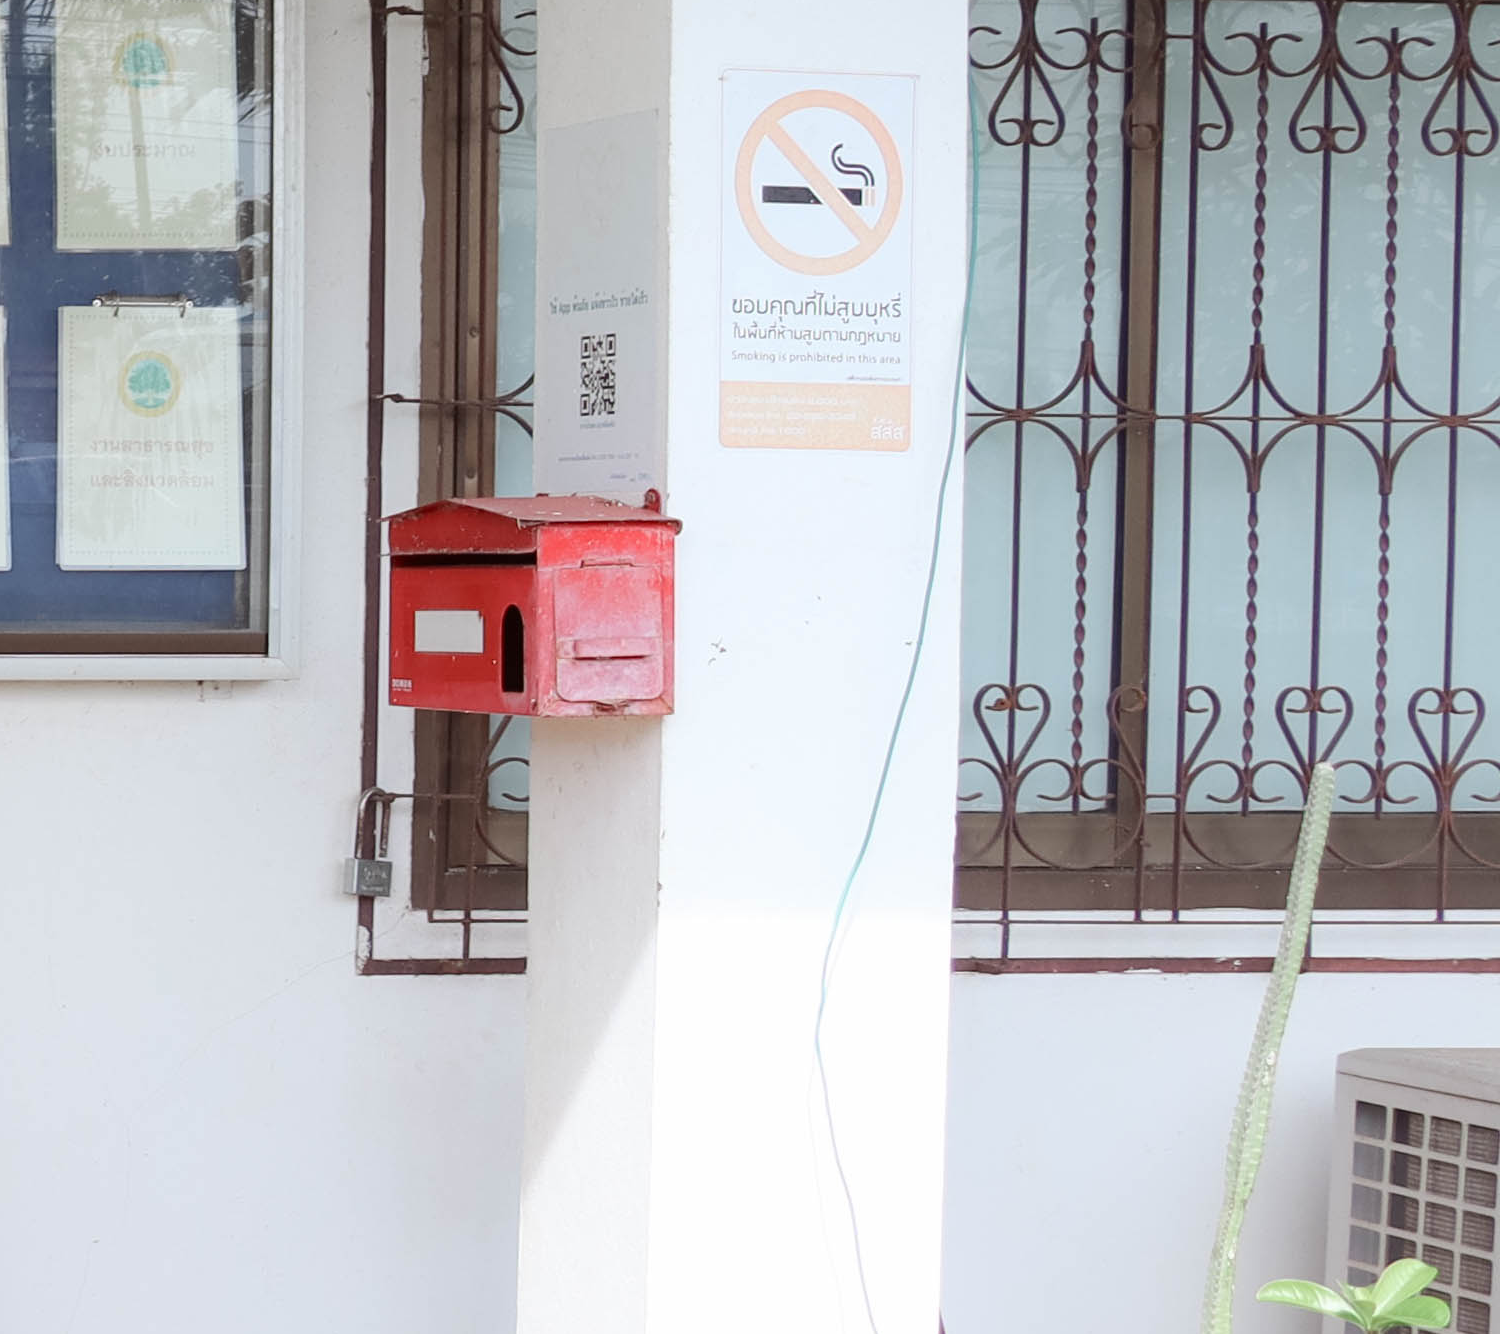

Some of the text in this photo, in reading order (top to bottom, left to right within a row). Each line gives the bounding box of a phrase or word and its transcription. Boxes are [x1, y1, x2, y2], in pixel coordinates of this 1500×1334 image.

[732, 290, 902, 324] ขอบคุณที่ไม่สูบบุหรี่
[732, 351, 776, 363] Smoking
[789, 353, 843, 364] prohibited
[858, 354, 877, 364] this
